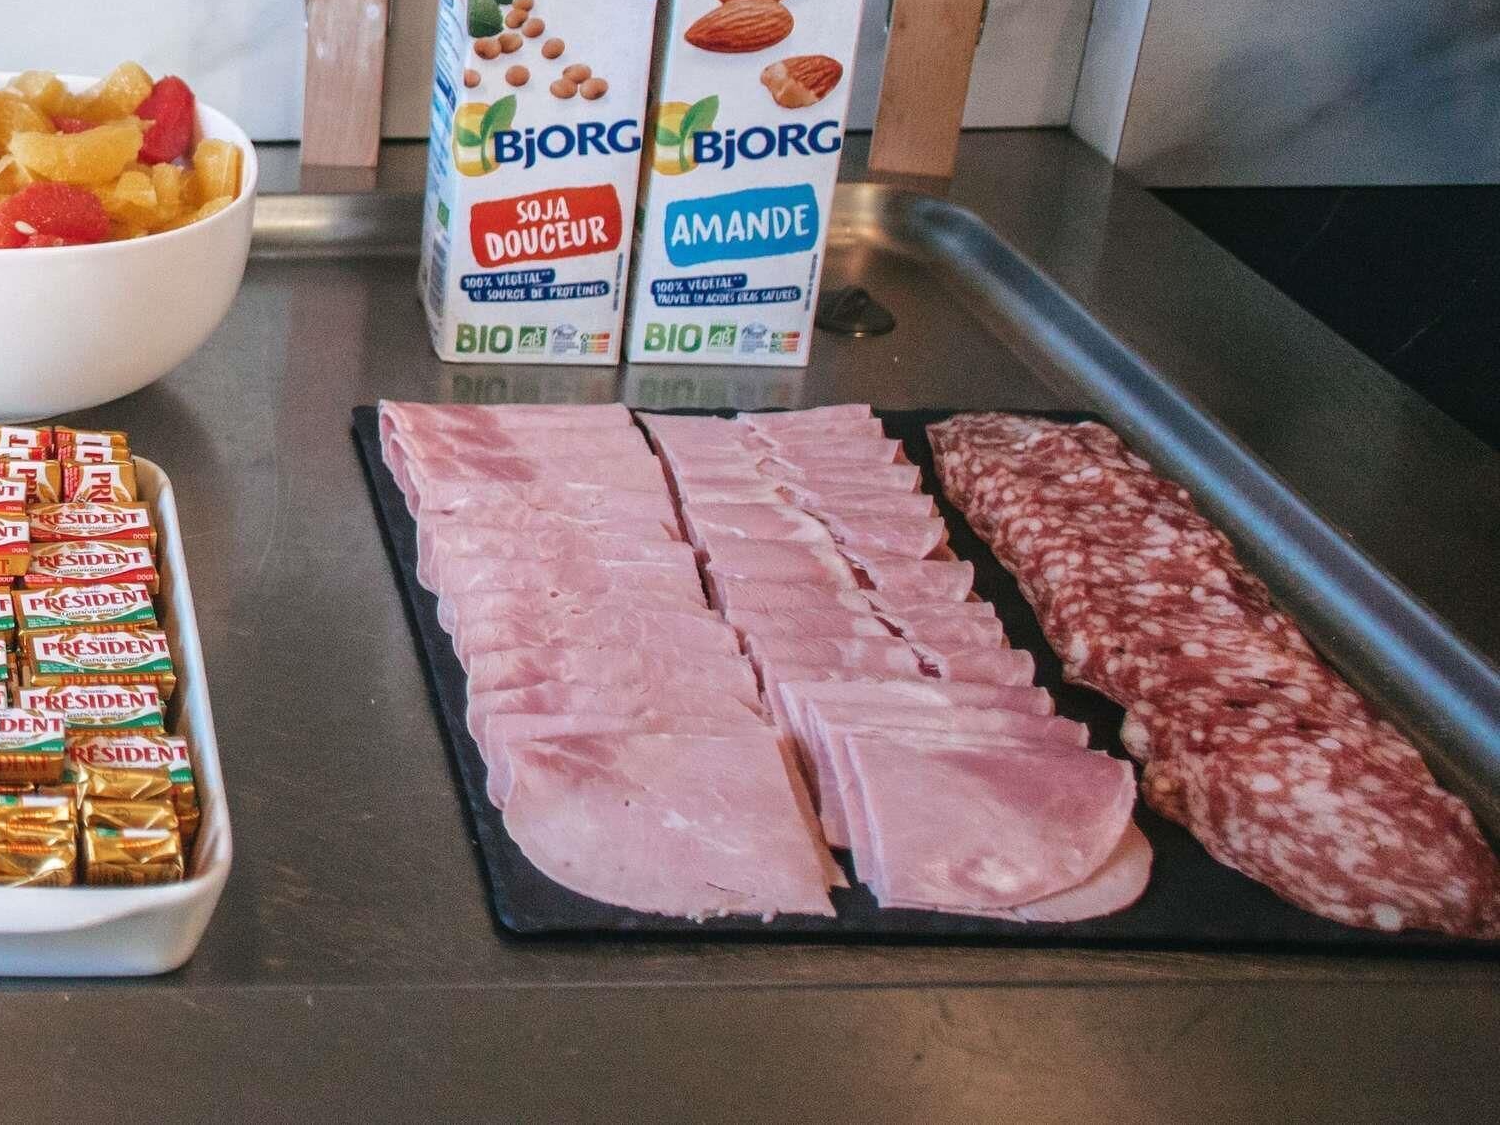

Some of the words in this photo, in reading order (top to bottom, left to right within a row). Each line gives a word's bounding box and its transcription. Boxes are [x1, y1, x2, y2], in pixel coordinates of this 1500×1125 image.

[516, 196, 570, 224] SOJA
[671, 204, 810, 247] AMANDE
[484, 216, 608, 261] DOUCEUR
[463, 276, 493, 288] 100%
[531, 287, 544, 299] DE
[655, 280, 683, 292] 100%
[455, 324, 513, 354] BIO
[644, 323, 703, 353] BIO
[30, 590, 149, 614] PRÉSIDENT
[42, 639, 167, 658] PRÉSIDENT
[29, 692, 159, 710] PRÉSIDENT
